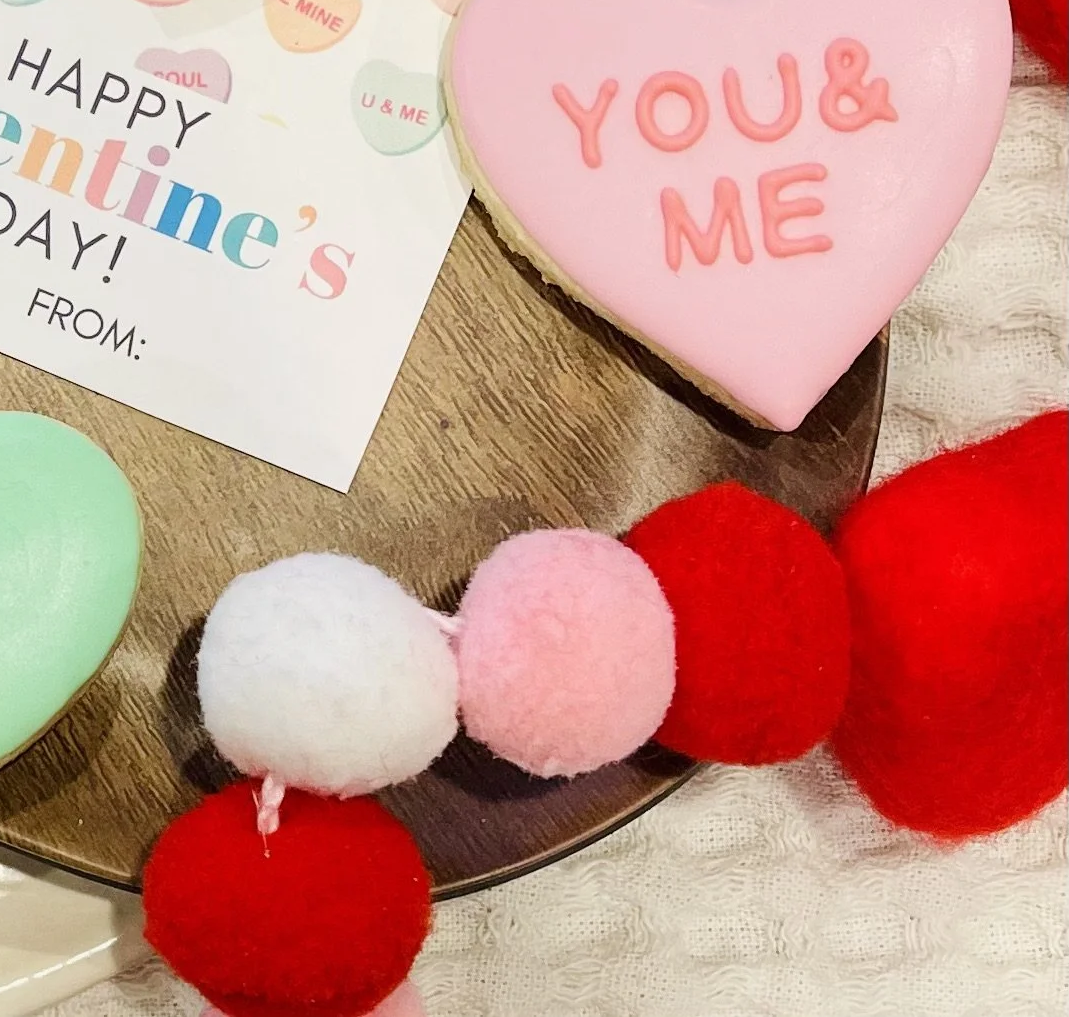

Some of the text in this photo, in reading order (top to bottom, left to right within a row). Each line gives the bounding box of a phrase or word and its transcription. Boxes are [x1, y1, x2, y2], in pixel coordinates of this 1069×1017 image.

[7, 37, 212, 150] HAPPY
[360, 92, 430, 126] U & ME
[660, 162, 833, 272] ME
[27, 288, 147, 361] FROM:
